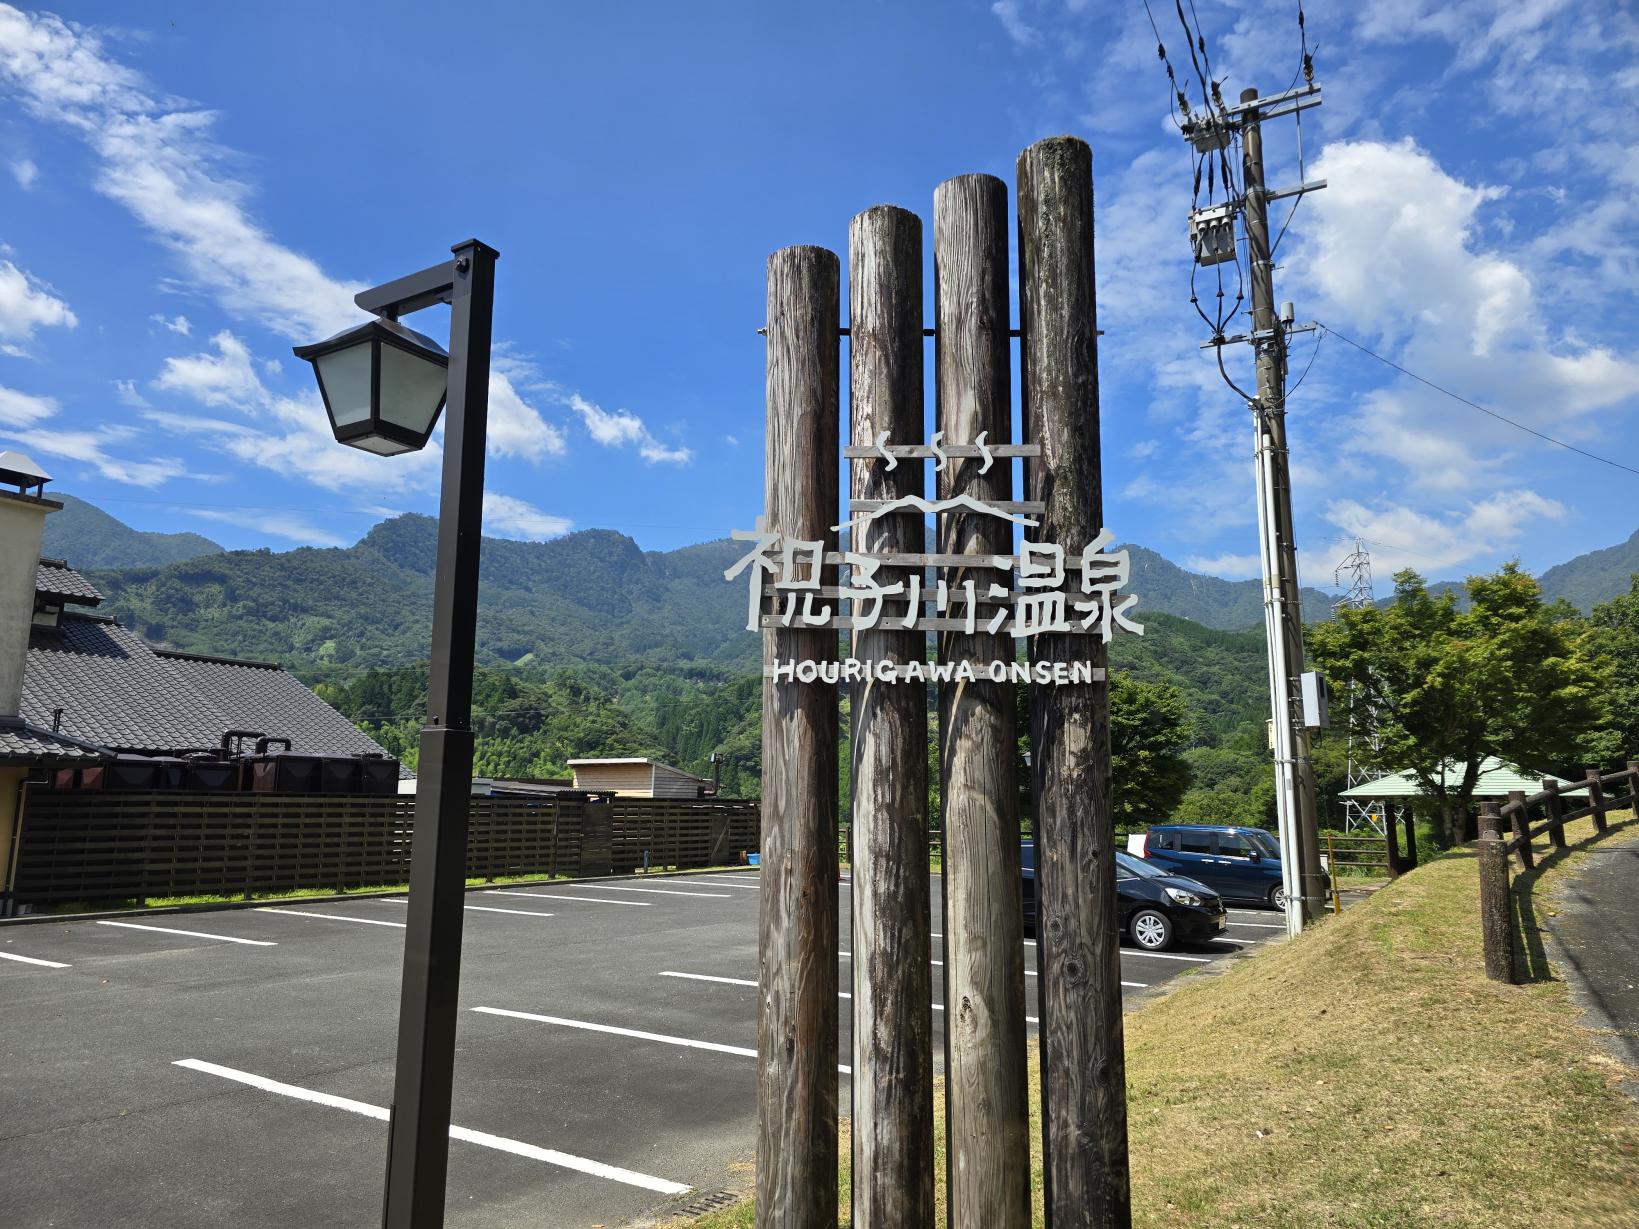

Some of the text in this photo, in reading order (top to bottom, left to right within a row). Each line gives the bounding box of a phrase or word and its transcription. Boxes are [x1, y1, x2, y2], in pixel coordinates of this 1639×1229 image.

[725, 517, 1144, 643] 祝子川温泉
[773, 658, 1092, 685] HOURIGAWA ONSEN
